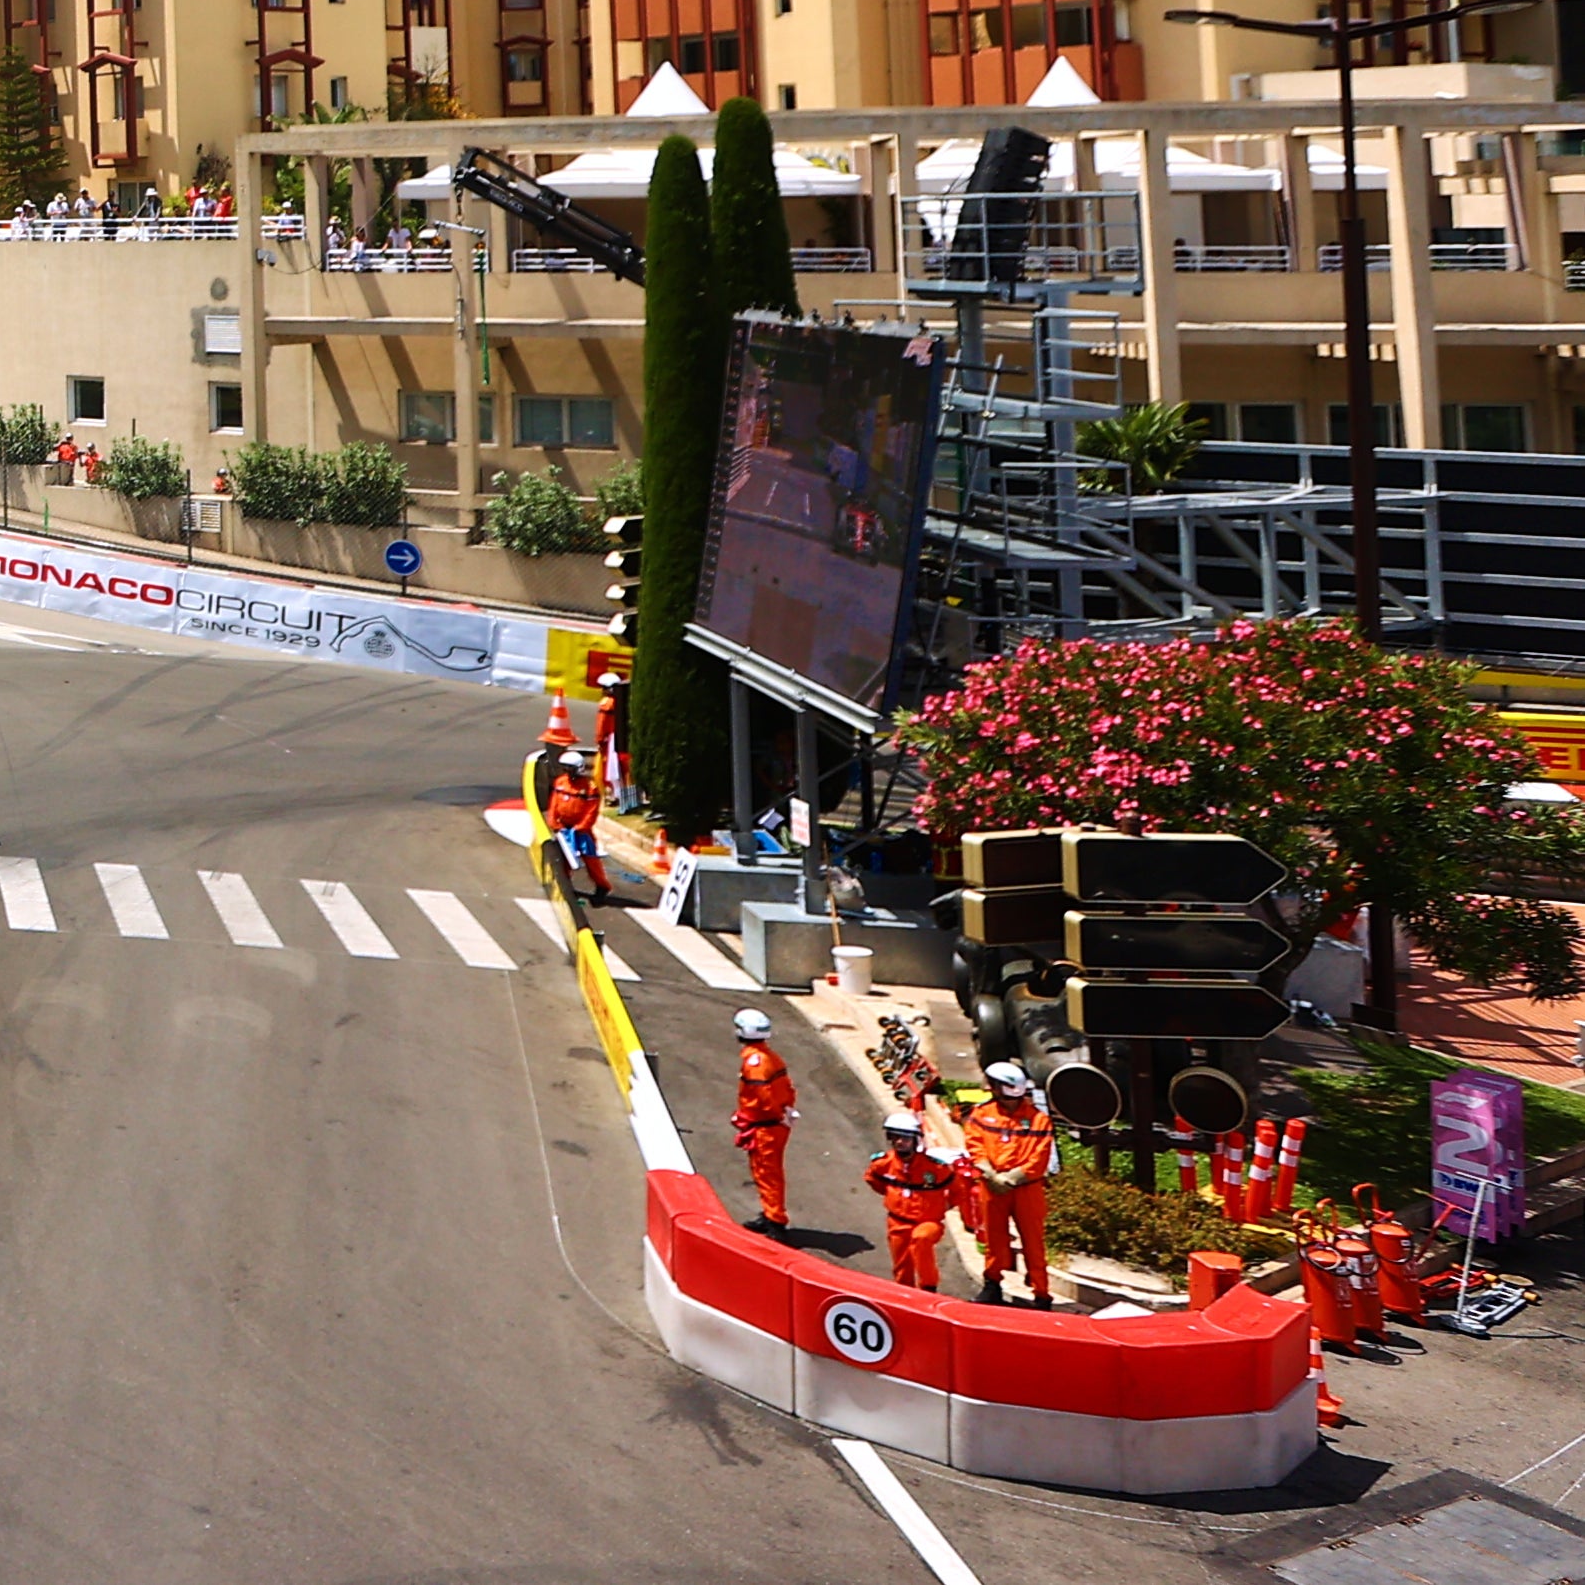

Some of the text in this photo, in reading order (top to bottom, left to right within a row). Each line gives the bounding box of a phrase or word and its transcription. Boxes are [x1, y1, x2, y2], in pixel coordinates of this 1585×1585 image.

[190, 617, 321, 649] SINCE 1929
[1437, 1115, 1489, 1176] 2
[833, 1312, 885, 1353] 60
